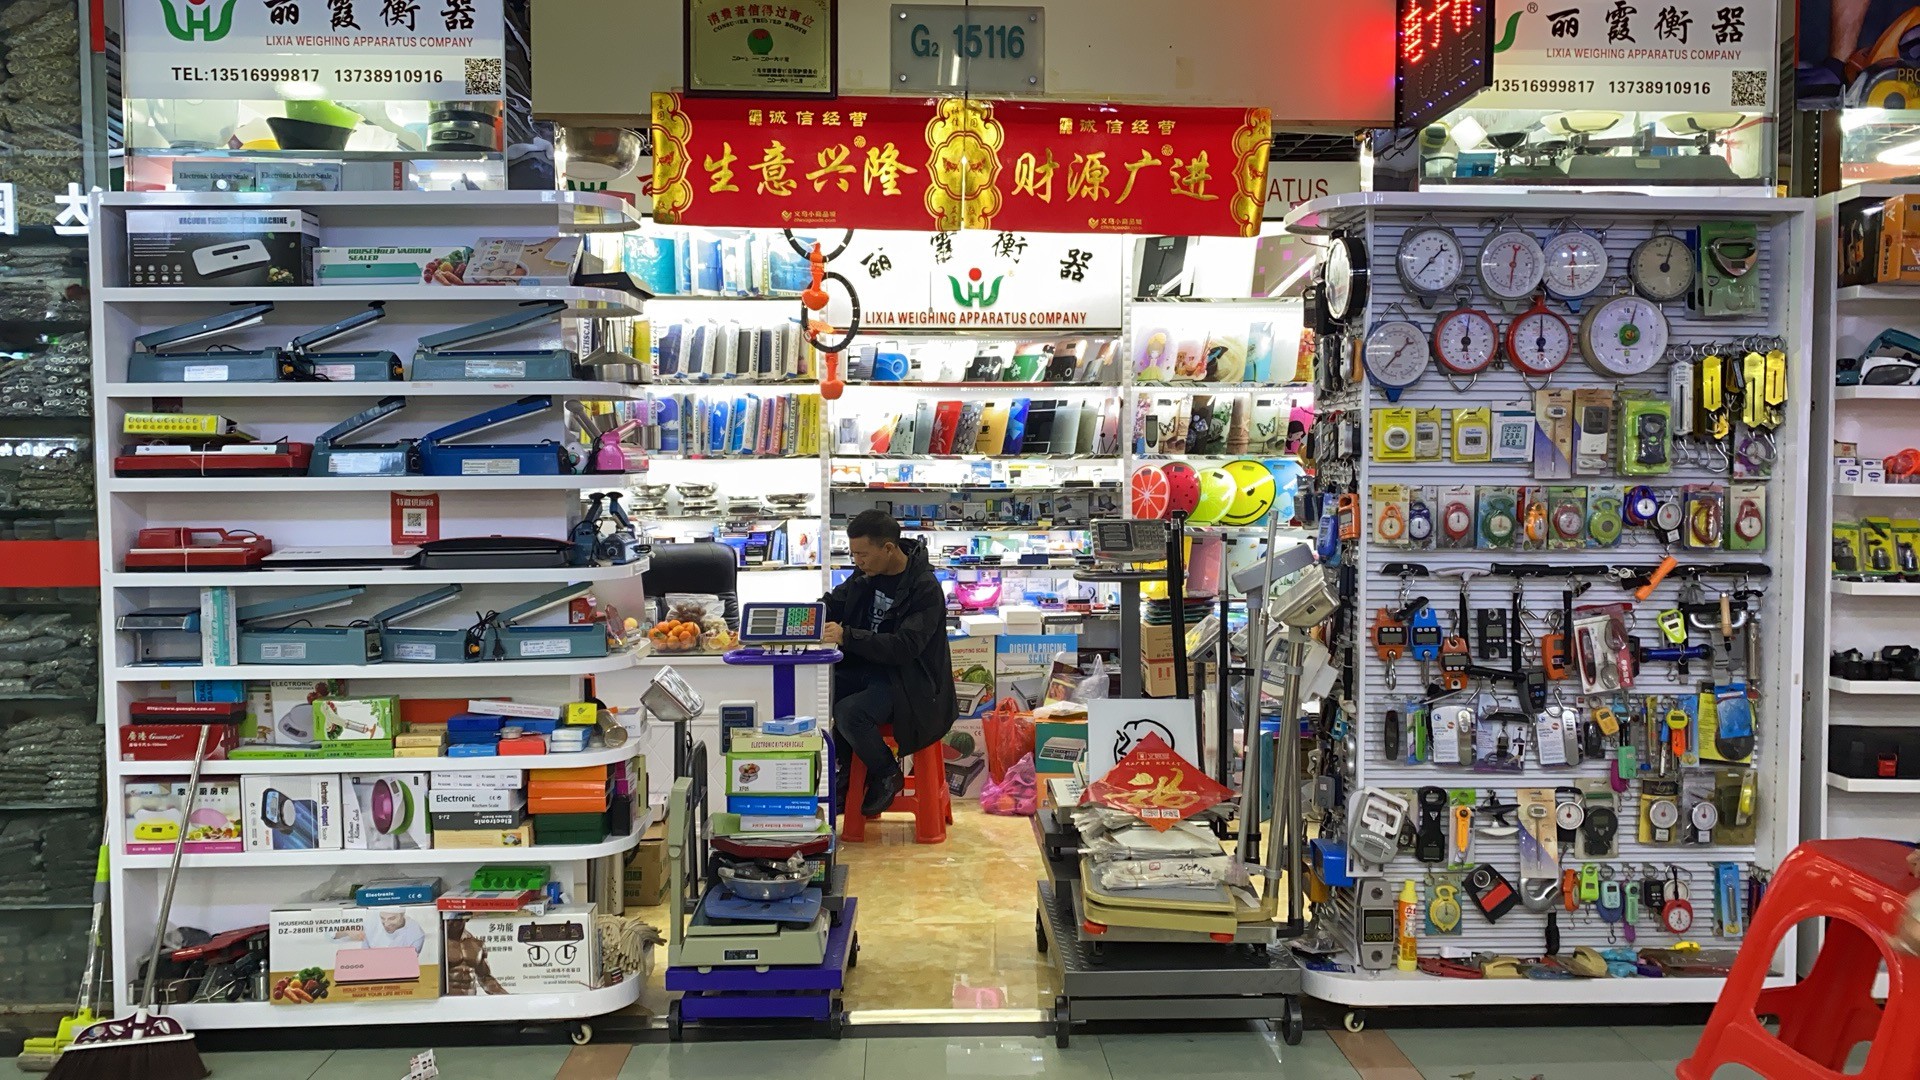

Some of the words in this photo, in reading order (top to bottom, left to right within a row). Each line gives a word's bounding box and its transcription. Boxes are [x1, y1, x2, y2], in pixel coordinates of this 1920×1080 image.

[264, 0, 477, 32] 丽霞衡器
[707, 4, 815, 28] 消费者信得过商位
[785, 22, 808, 34] BOOTH
[1546, 3, 1746, 45] 丽霞衡器
[266, 35, 294, 48] LIXIA
[295, 36, 351, 48] WEIGHING
[353, 37, 418, 48] APPARATUS
[419, 37, 474, 48] COMPANY
[953, 25, 1025, 58] 15116
[1546, 48, 1572, 60] LIXIA
[1574, 49, 1625, 60] WEIGHING
[1627, 49, 1689, 61] APPARATUS
[1691, 50, 1742, 61] COMPANY
[171, 67, 319, 83] TEL:13516999817
[334, 69, 443, 84] 13738910916
[1494, 79, 1595, 95] 13516999817
[1607, 81, 1711, 96] 13738910916
[768, 110, 869, 127] 诚信经营
[1079, 119, 1177, 136] 诚信经营
[703, 139, 918, 197] 生意兴隆
[1011, 147, 1220, 204] 财源广进
[258, 216, 288, 225] MACHINE
[397, 247, 432, 255] VACUUM
[865, 311, 895, 324] LIXIA
[898, 311, 956, 324] WEIGHING
[959, 312, 1028, 325] APPARATUS
[1029, 312, 1087, 325] COMPANY
[1504, 425, 1522, 433] 12:00
[1009, 643, 1038, 653] DIGITAL
[1039, 642, 1067, 653] PRICING
[1028, 653, 1050, 663] SCALE
[751, 741, 774, 749] ELECTRONIC
[316, 925, 364, 933] (STANDARD)
[488, 923, 514, 932] 多功能
